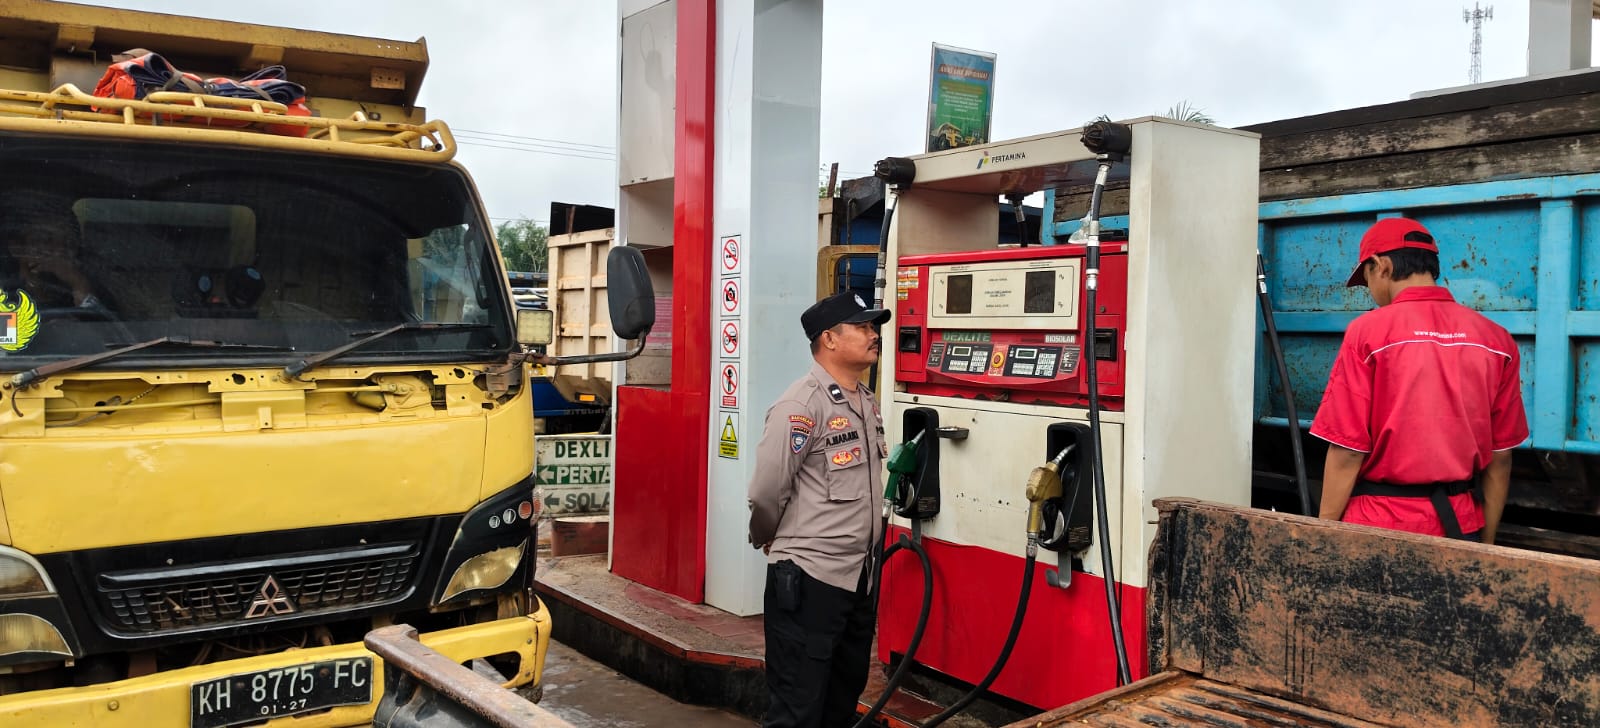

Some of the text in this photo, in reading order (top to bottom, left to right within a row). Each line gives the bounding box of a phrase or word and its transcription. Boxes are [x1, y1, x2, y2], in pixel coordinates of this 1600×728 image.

[991, 152, 1026, 163] PERTAMINA
[1045, 334, 1075, 343] BIOSOLAR
[199, 659, 366, 715] KH 8775 FC
